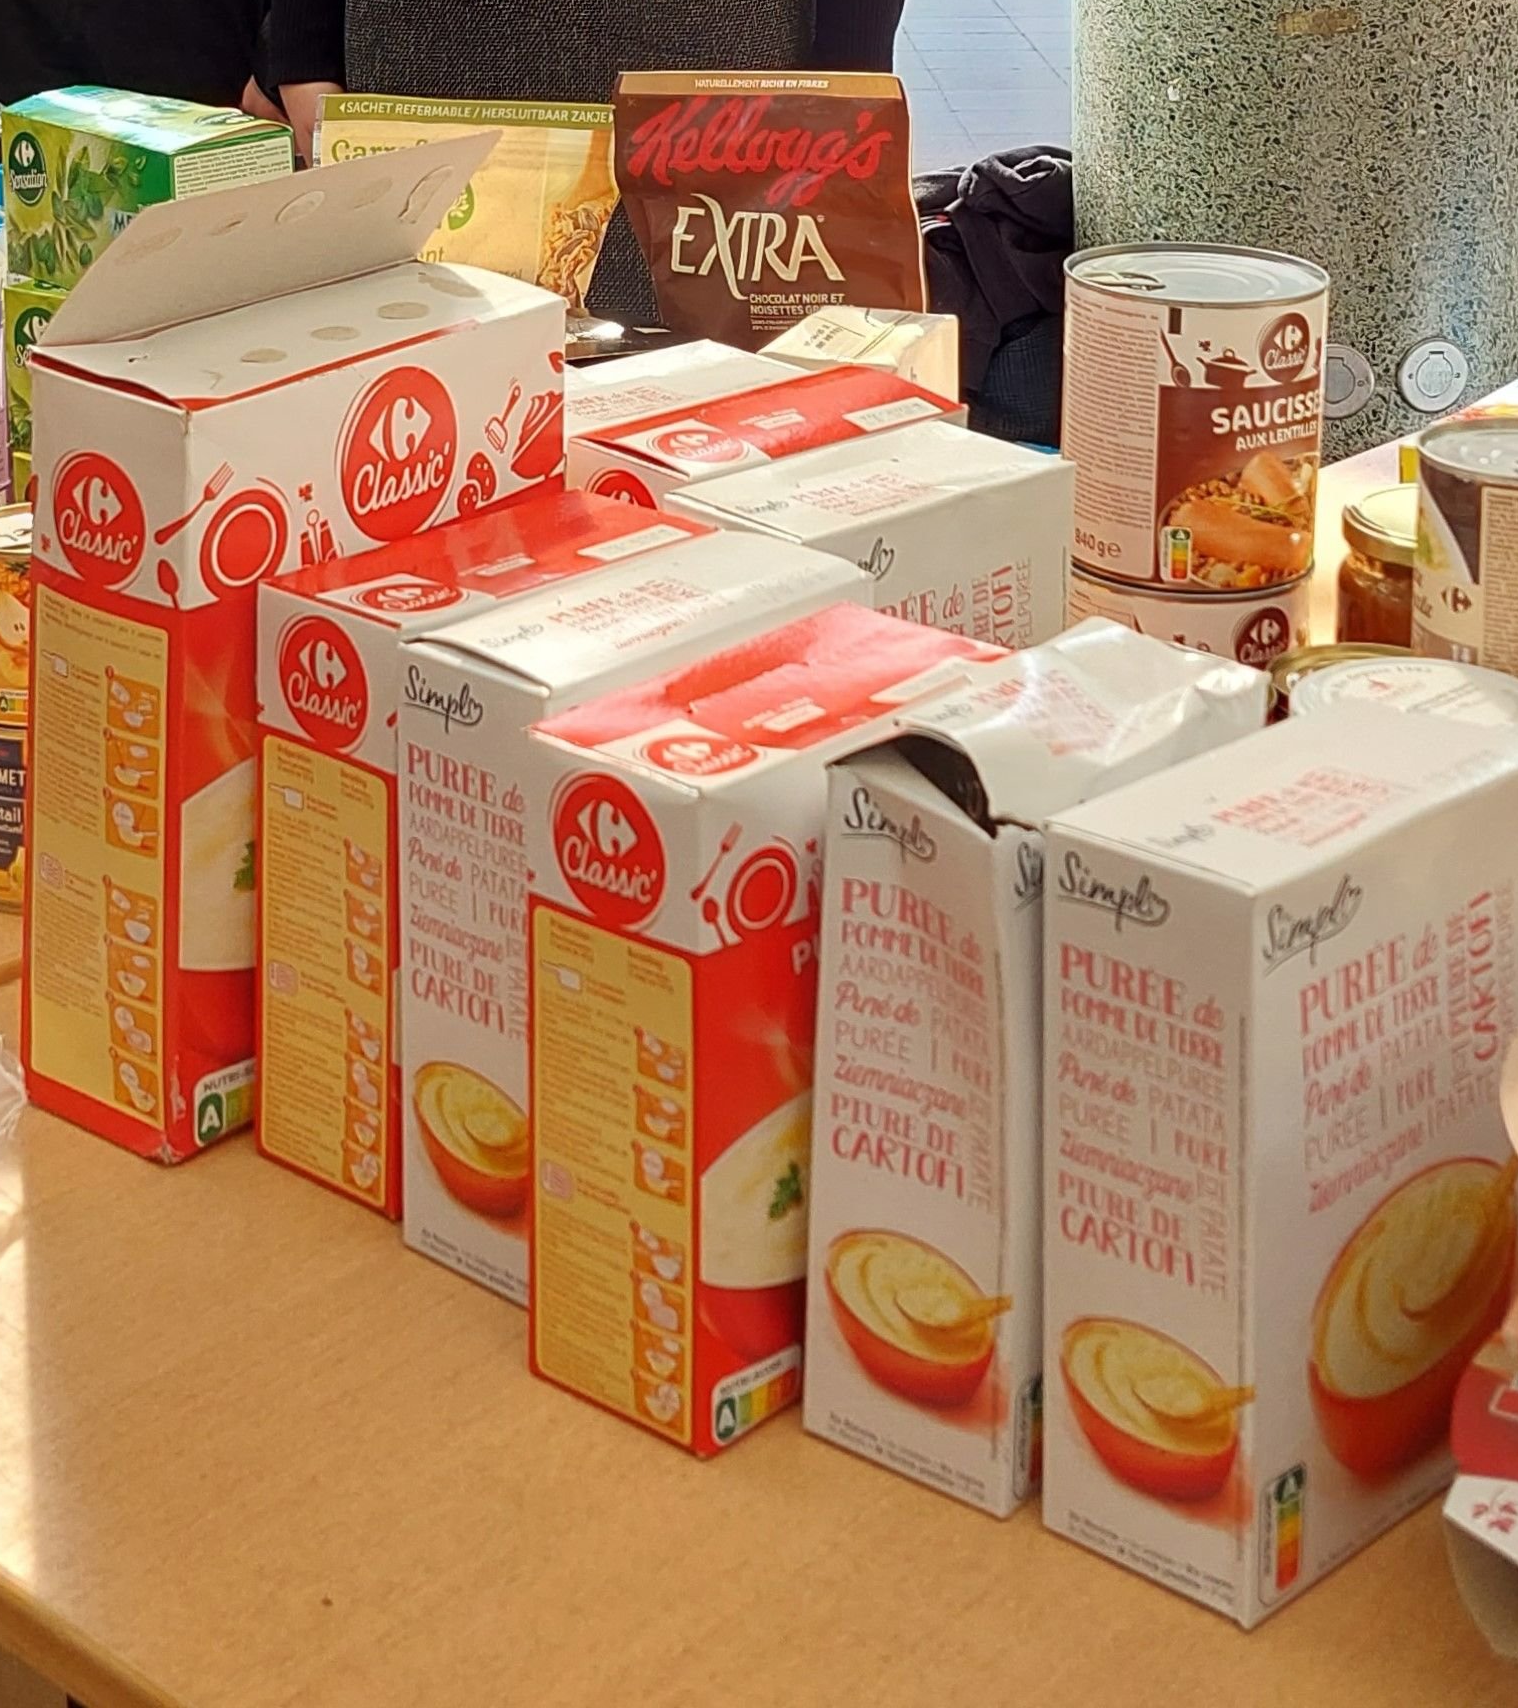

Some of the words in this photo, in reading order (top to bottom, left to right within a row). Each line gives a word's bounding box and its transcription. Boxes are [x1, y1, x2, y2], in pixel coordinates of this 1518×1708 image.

[346, 101, 394, 114] SACHET
[395, 103, 471, 118] REFERMABLE
[482, 108, 568, 121] HERSLUITBAAR
[571, 110, 607, 123] ZAKJE
[627, 95, 892, 207] Kellogg's
[10, 169, 48, 190] Sensation
[671, 193, 846, 300] EXTRA
[749, 293, 801, 304] CHOCOLAT
[802, 293, 828, 304] NOIR
[830, 293, 845, 304] ET
[750, 304, 804, 315] NOISETTES
[1236, 432, 1268, 452] AUX
[1269, 420, 1318, 446] LENTILLES
[1074, 528, 1096, 554] 840
[409, 780, 457, 818] POMME
[460, 797, 479, 827] DE
[485, 806, 526, 846] TERRE
[502, 783, 525, 813] de
[842, 920, 913, 958] POMME
[411, 937, 471, 986] PIURE
[472, 967, 496, 995] DE
[1469, 891, 1499, 1062] CARTOFI
[412, 971, 505, 1035] CARTOFI
[1193, 996, 1225, 1033] de
[1365, 1003, 1386, 1041] DE
[1061, 986, 1126, 1033] POMME
[1134, 1007, 1158, 1044] DE
[1168, 1022, 1224, 1069] TERRE
[201, 1104, 220, 1133] A
[831, 1091, 917, 1137] PIURE
[926, 1122, 957, 1159] DE
[831, 1125, 964, 1199] CARTOFI
[1060, 1167, 1139, 1224] PIURE
[1151, 1204, 1184, 1242] DE
[1061, 1206, 1194, 1288] CARTOFI
